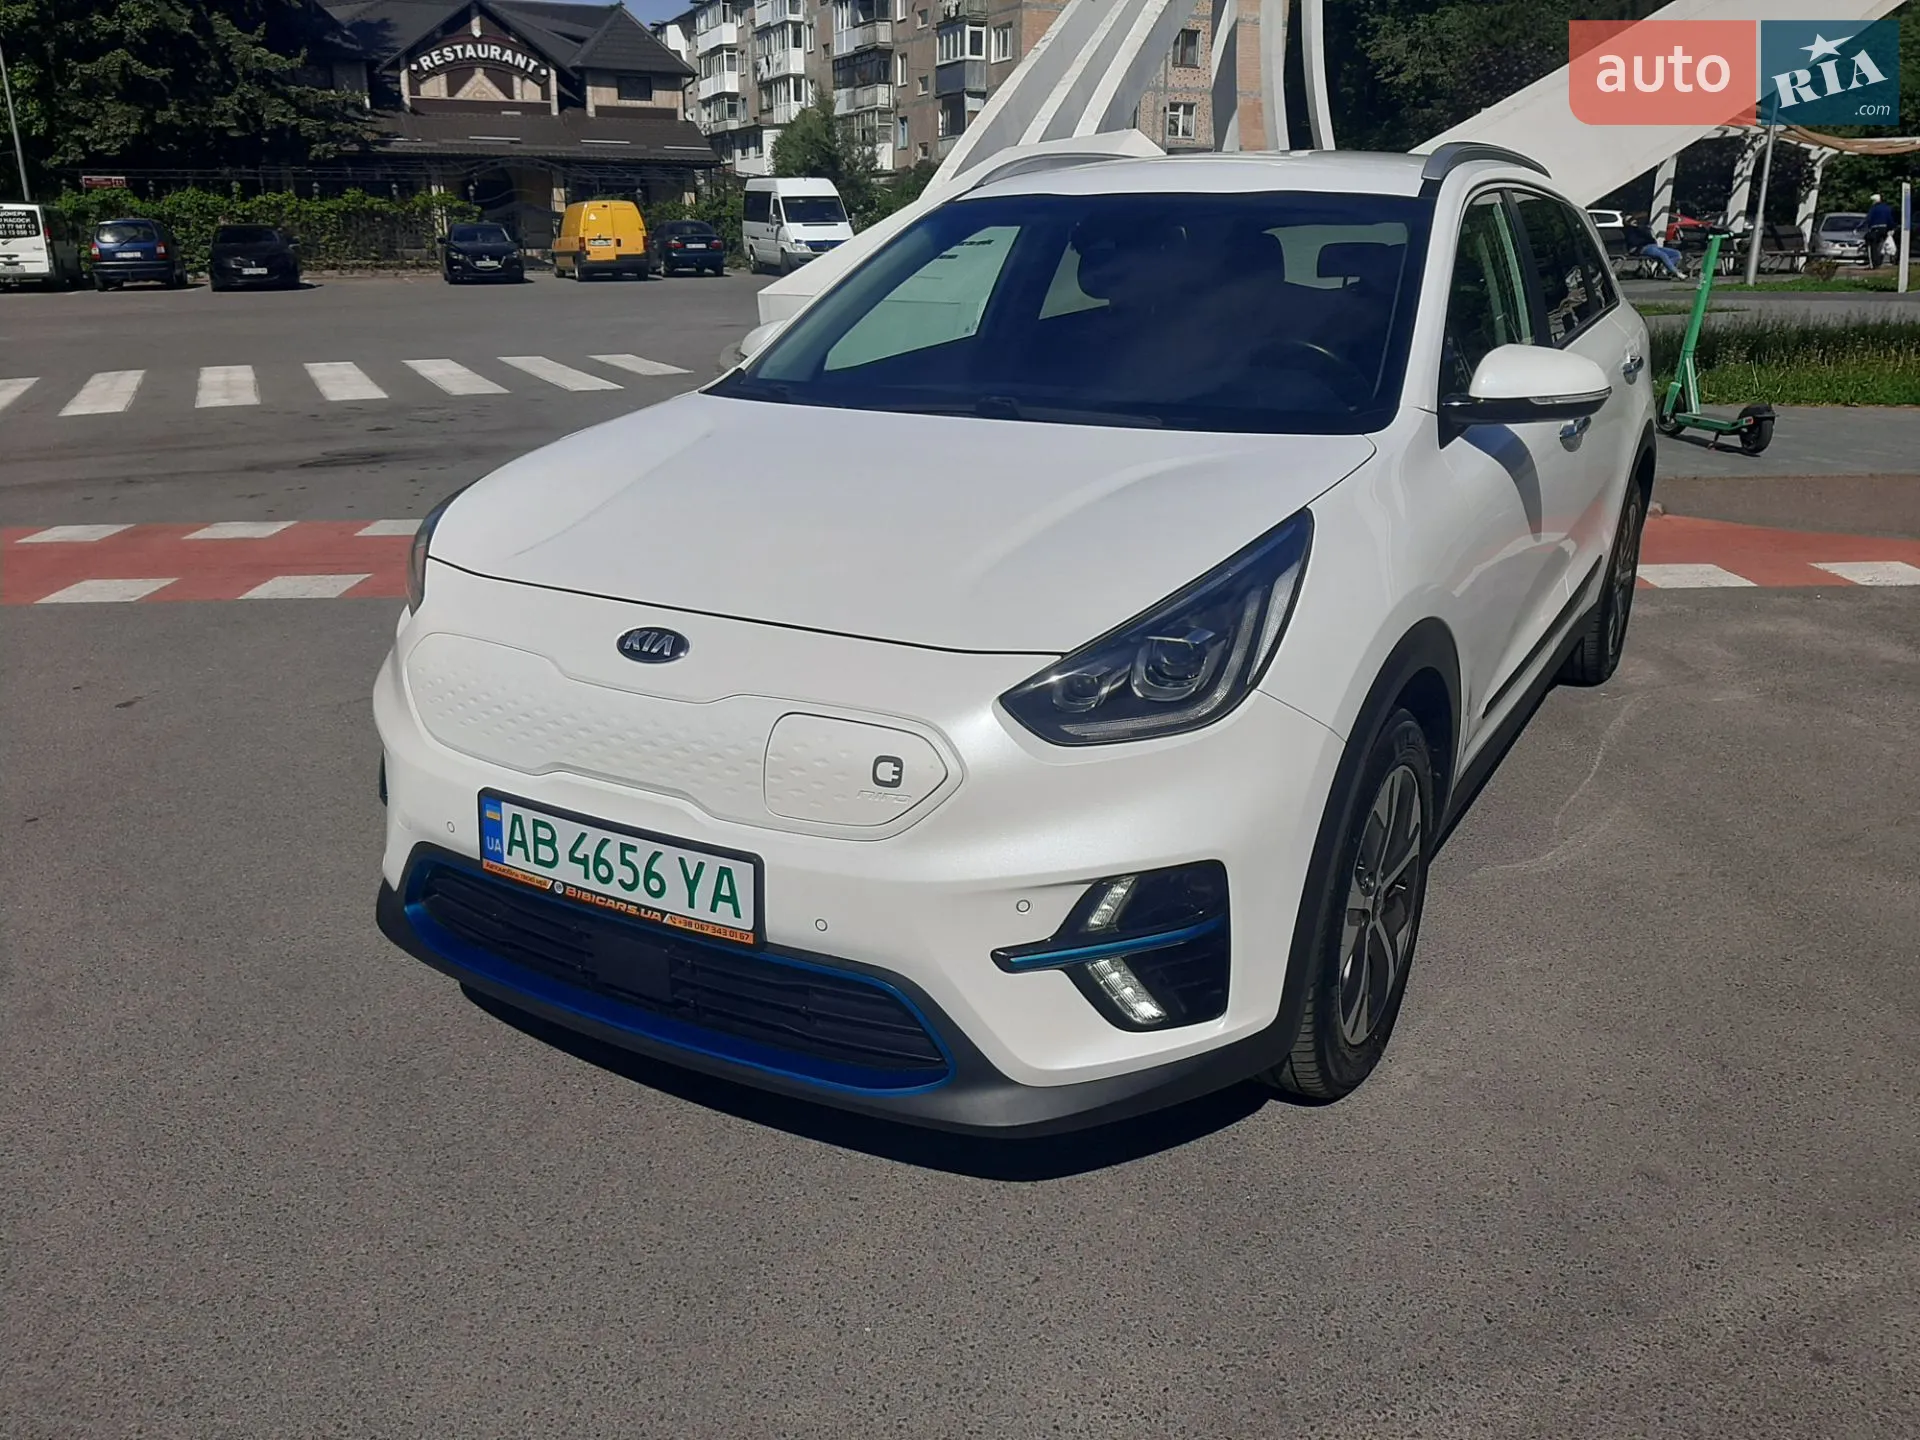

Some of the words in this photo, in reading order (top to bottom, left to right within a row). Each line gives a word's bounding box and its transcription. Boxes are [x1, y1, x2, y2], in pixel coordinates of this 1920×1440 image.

[419, 44, 539, 73] RESTAURANT
[624, 631, 674, 656] KIA
[486, 835, 502, 853] UA
[507, 812, 559, 869] AB
[568, 832, 667, 899] 4656
[678, 856, 742, 919] YA
[565, 886, 662, 922] BIBICARS.UA
